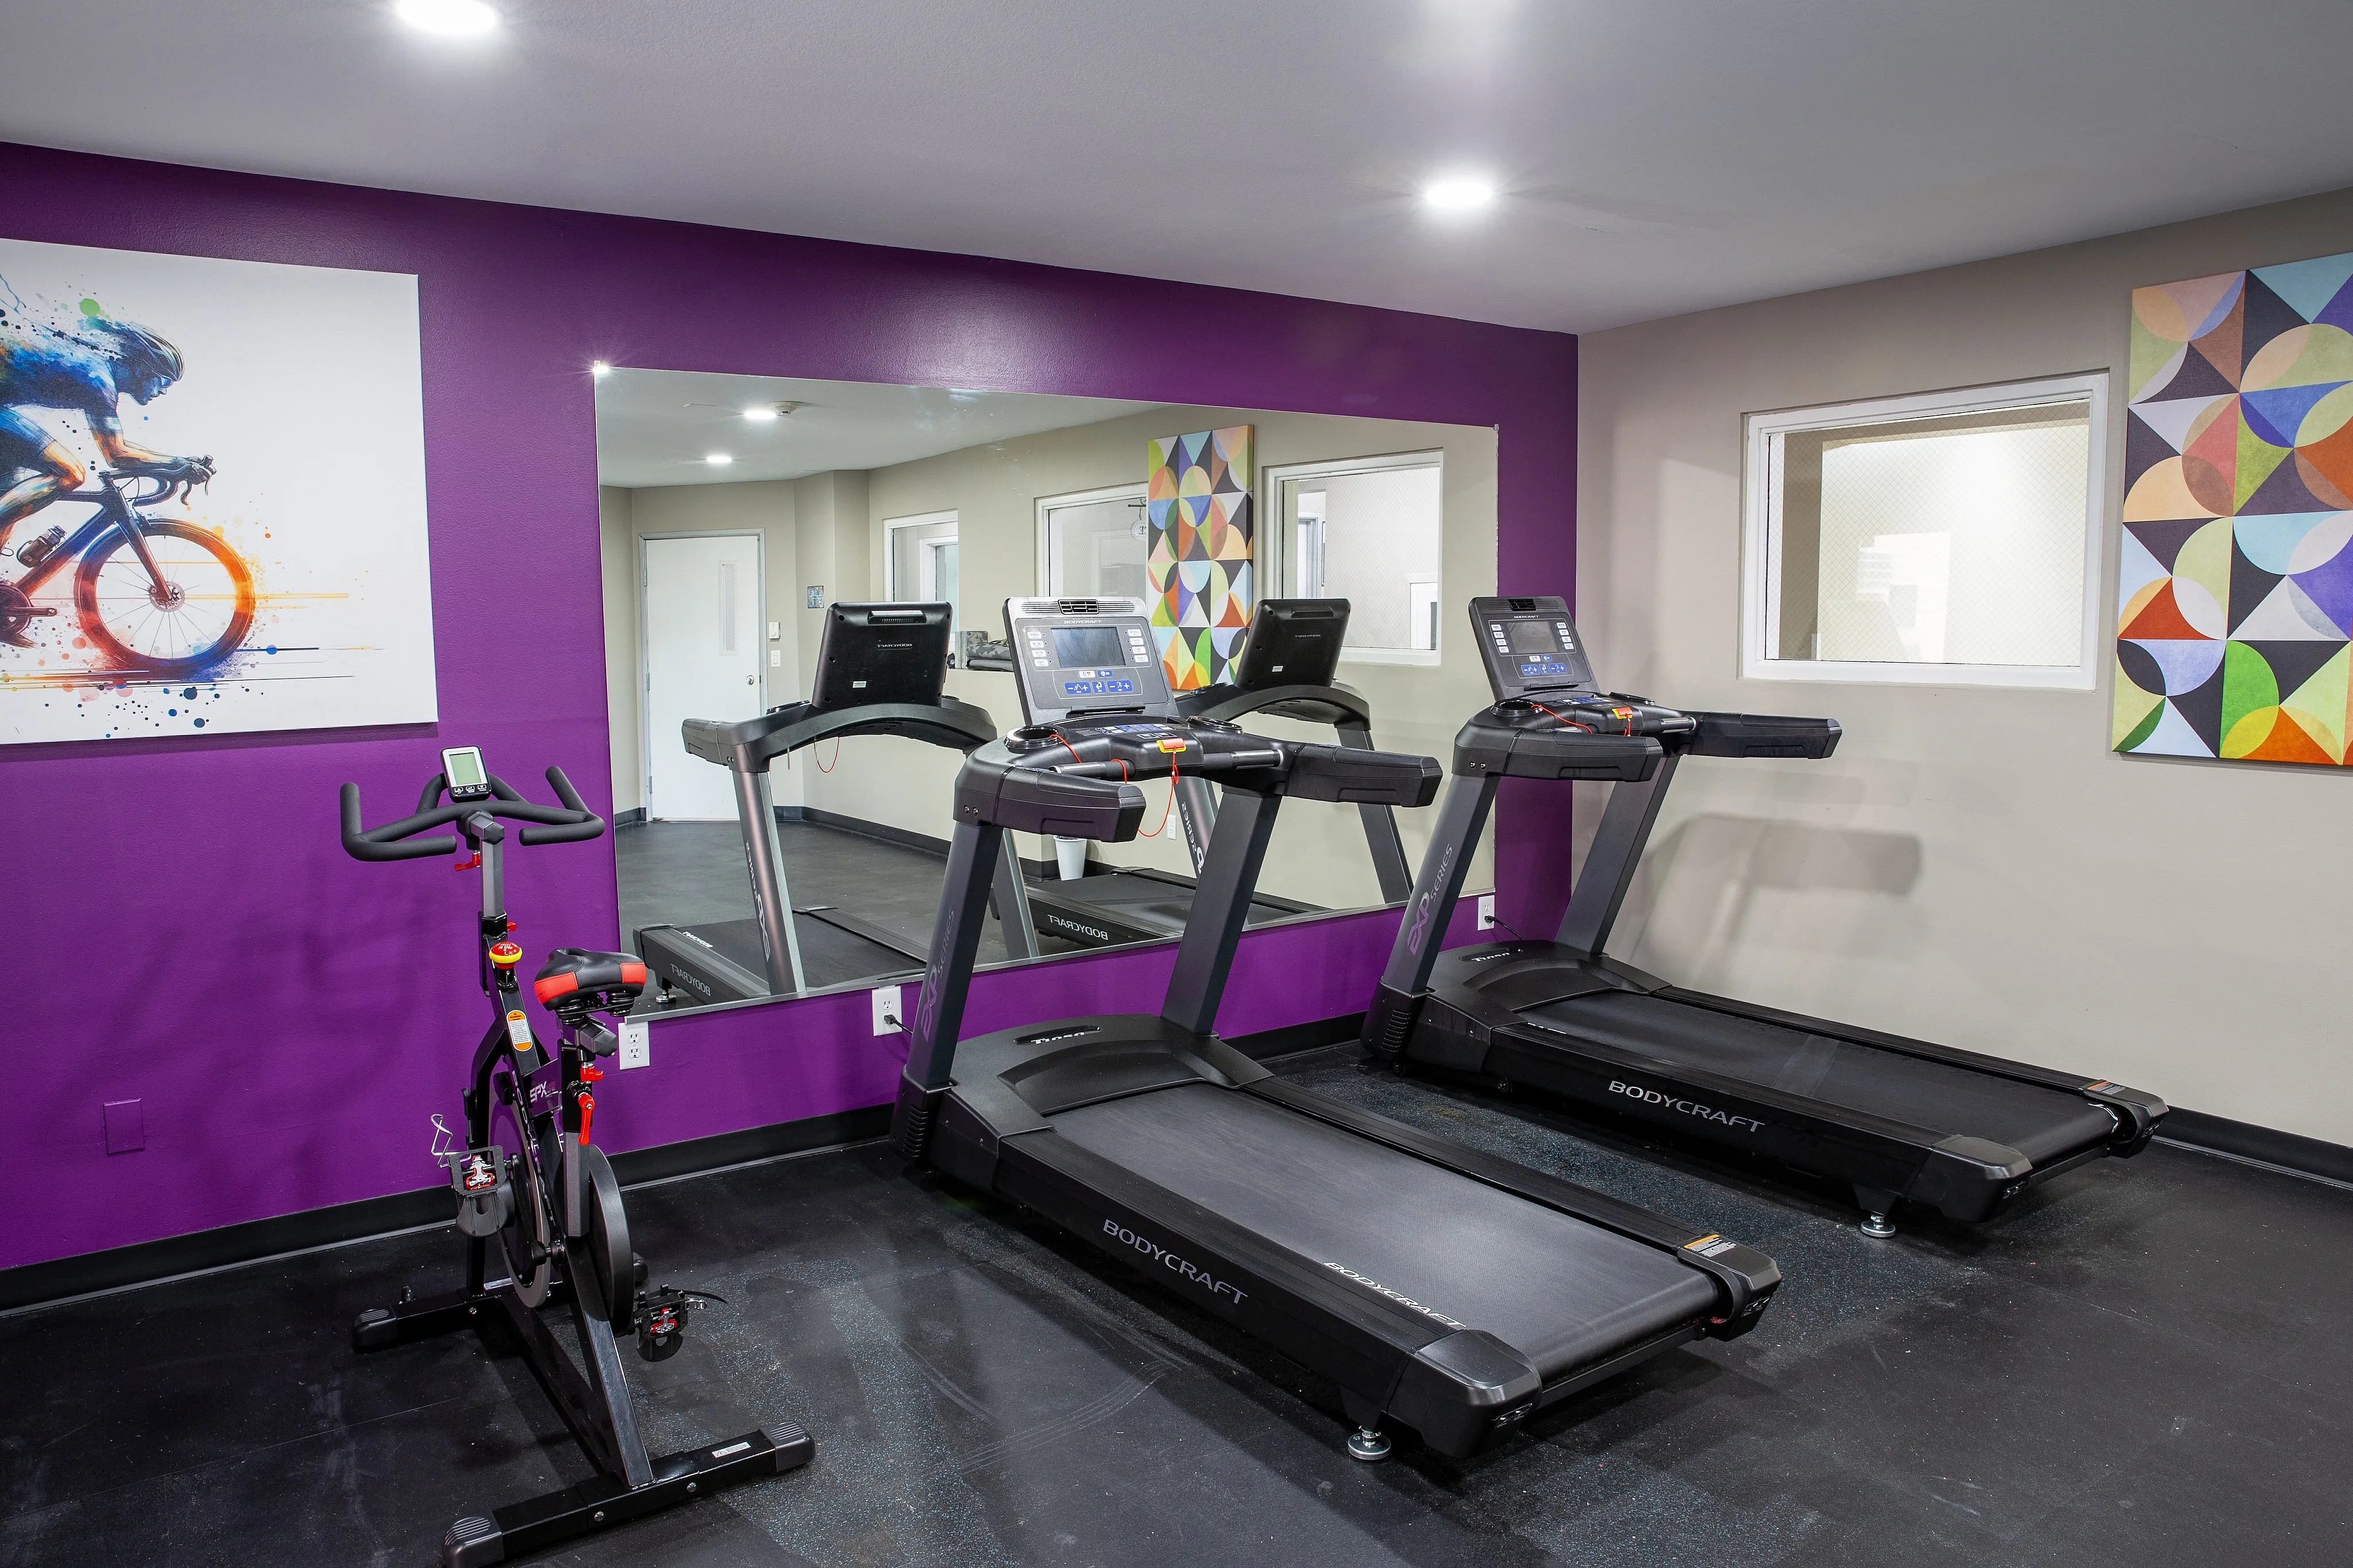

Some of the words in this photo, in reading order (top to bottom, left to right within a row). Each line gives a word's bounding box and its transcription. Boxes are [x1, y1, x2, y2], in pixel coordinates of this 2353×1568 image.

[1407, 891, 1430, 956] EXP
[1430, 843, 1453, 902] SERIES
[920, 964, 938, 1042] EXP
[937, 906, 955, 978] SERIES
[1608, 1080, 1766, 1133] BODYCRAFT
[1103, 1219, 1248, 1305] BODYCRAFT
[1323, 1262, 1468, 1328] BODYCRAFT
